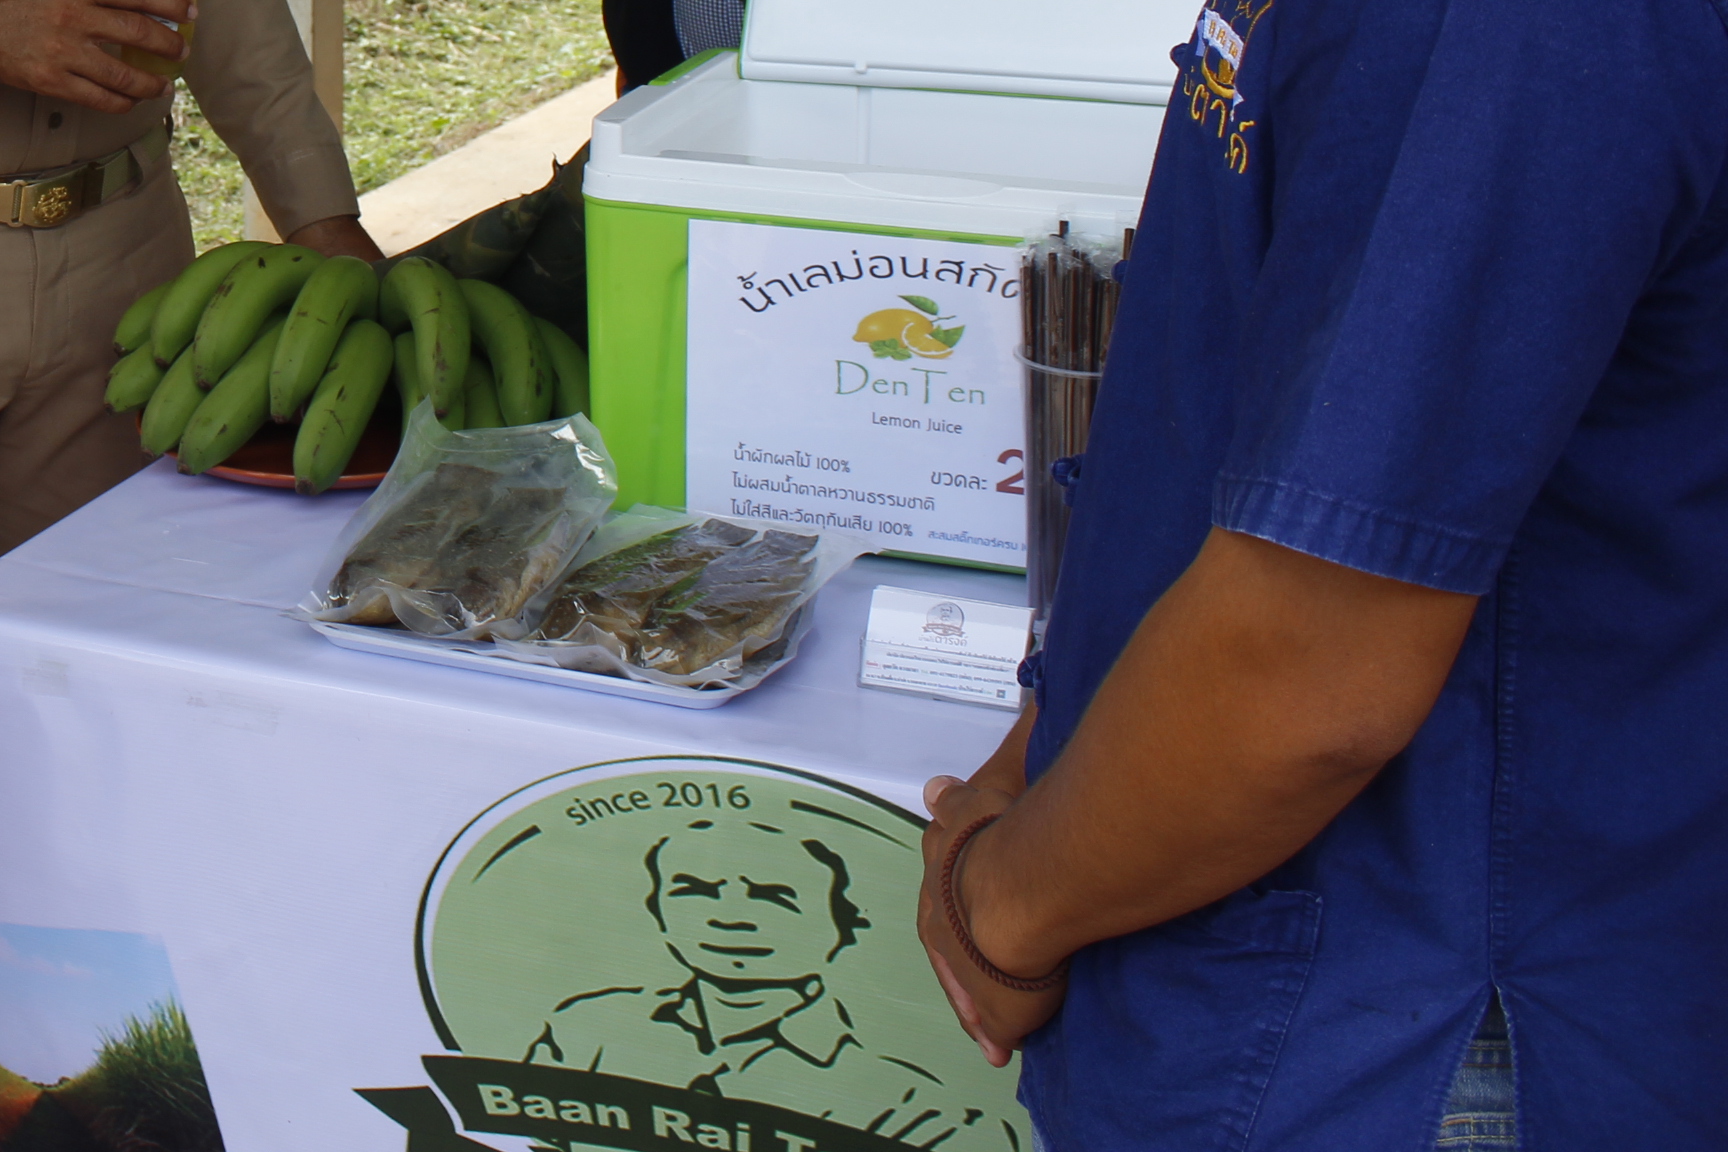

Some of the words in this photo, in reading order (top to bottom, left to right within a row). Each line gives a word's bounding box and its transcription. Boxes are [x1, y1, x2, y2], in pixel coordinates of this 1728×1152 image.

[872, 412, 921, 430] Lemon
[926, 418, 963, 435] Juice
[734, 441, 812, 468] น้ำผักผลไม้
[930, 470, 988, 490] ขวดละ
[565, 788, 652, 826] since
[656, 781, 752, 810] 2016
[476, 1083, 632, 1131] Baan
[651, 1104, 752, 1152] Rai
